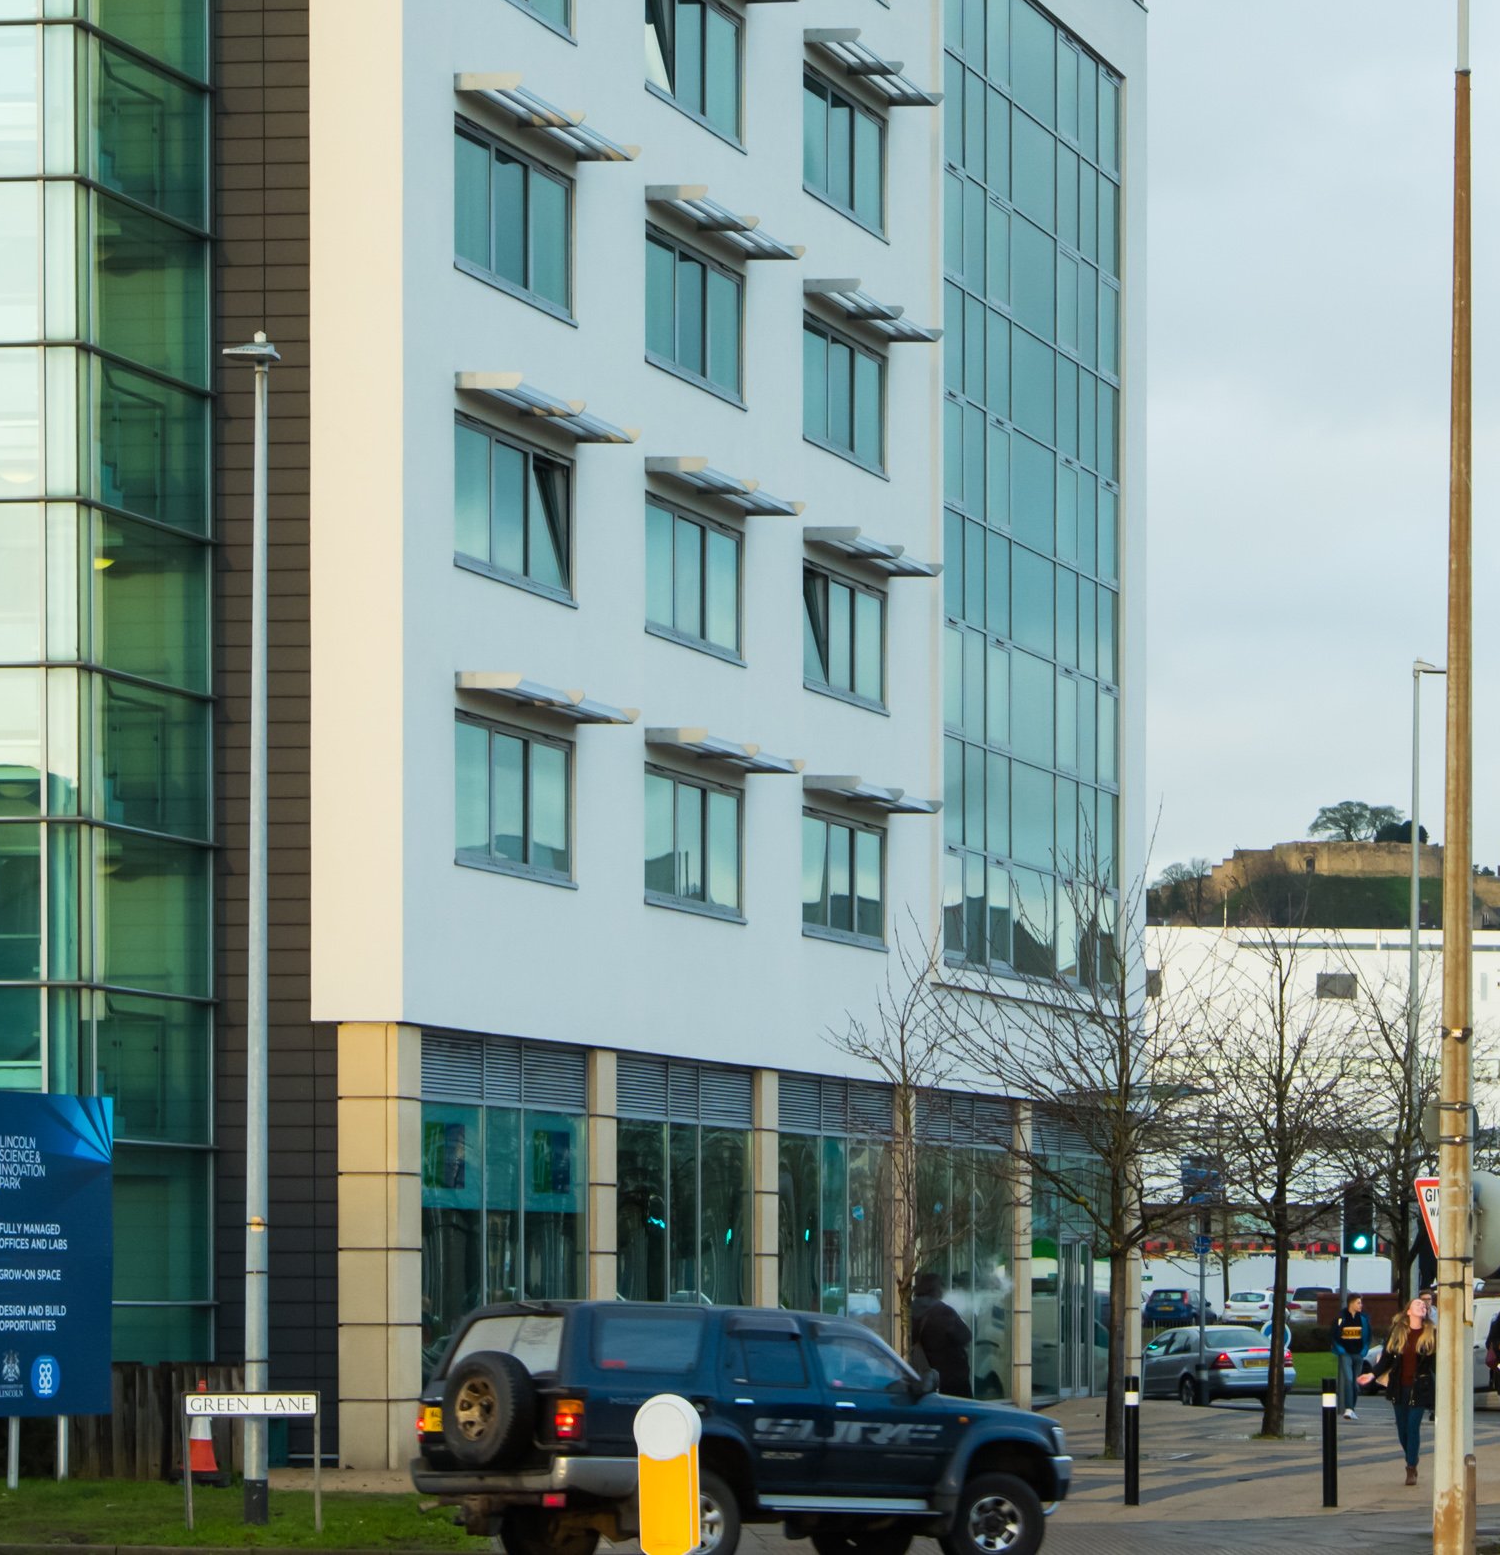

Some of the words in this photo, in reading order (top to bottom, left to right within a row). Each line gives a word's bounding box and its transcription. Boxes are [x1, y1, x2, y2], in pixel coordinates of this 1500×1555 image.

[0, 1135, 36, 1149] LINCOLN
[0, 1149, 35, 1163] SCIENCE
[35, 1150, 42, 1163] &
[0, 1163, 46, 1177] INNOVATION
[0, 1176, 21, 1189] PARK
[1425, 1188, 1440, 1202] GI
[0, 1223, 22, 1234] FULLY
[23, 1224, 61, 1235] MANAGED
[31, 1238, 47, 1250] AND
[48, 1239, 68, 1250] LABS
[37, 1269, 61, 1281] SPACE
[0, 1305, 26, 1316] DESIGN
[27, 1305, 43, 1316] AND
[45, 1305, 67, 1316] BUILD
[0, 1320, 57, 1331] OPPORTUNITIES
[0, 1390, 24, 1398] LINCOLN
[190, 1397, 249, 1412] GREEN
[263, 1397, 311, 1411] LANE
[752, 1417, 944, 1445] SURF
